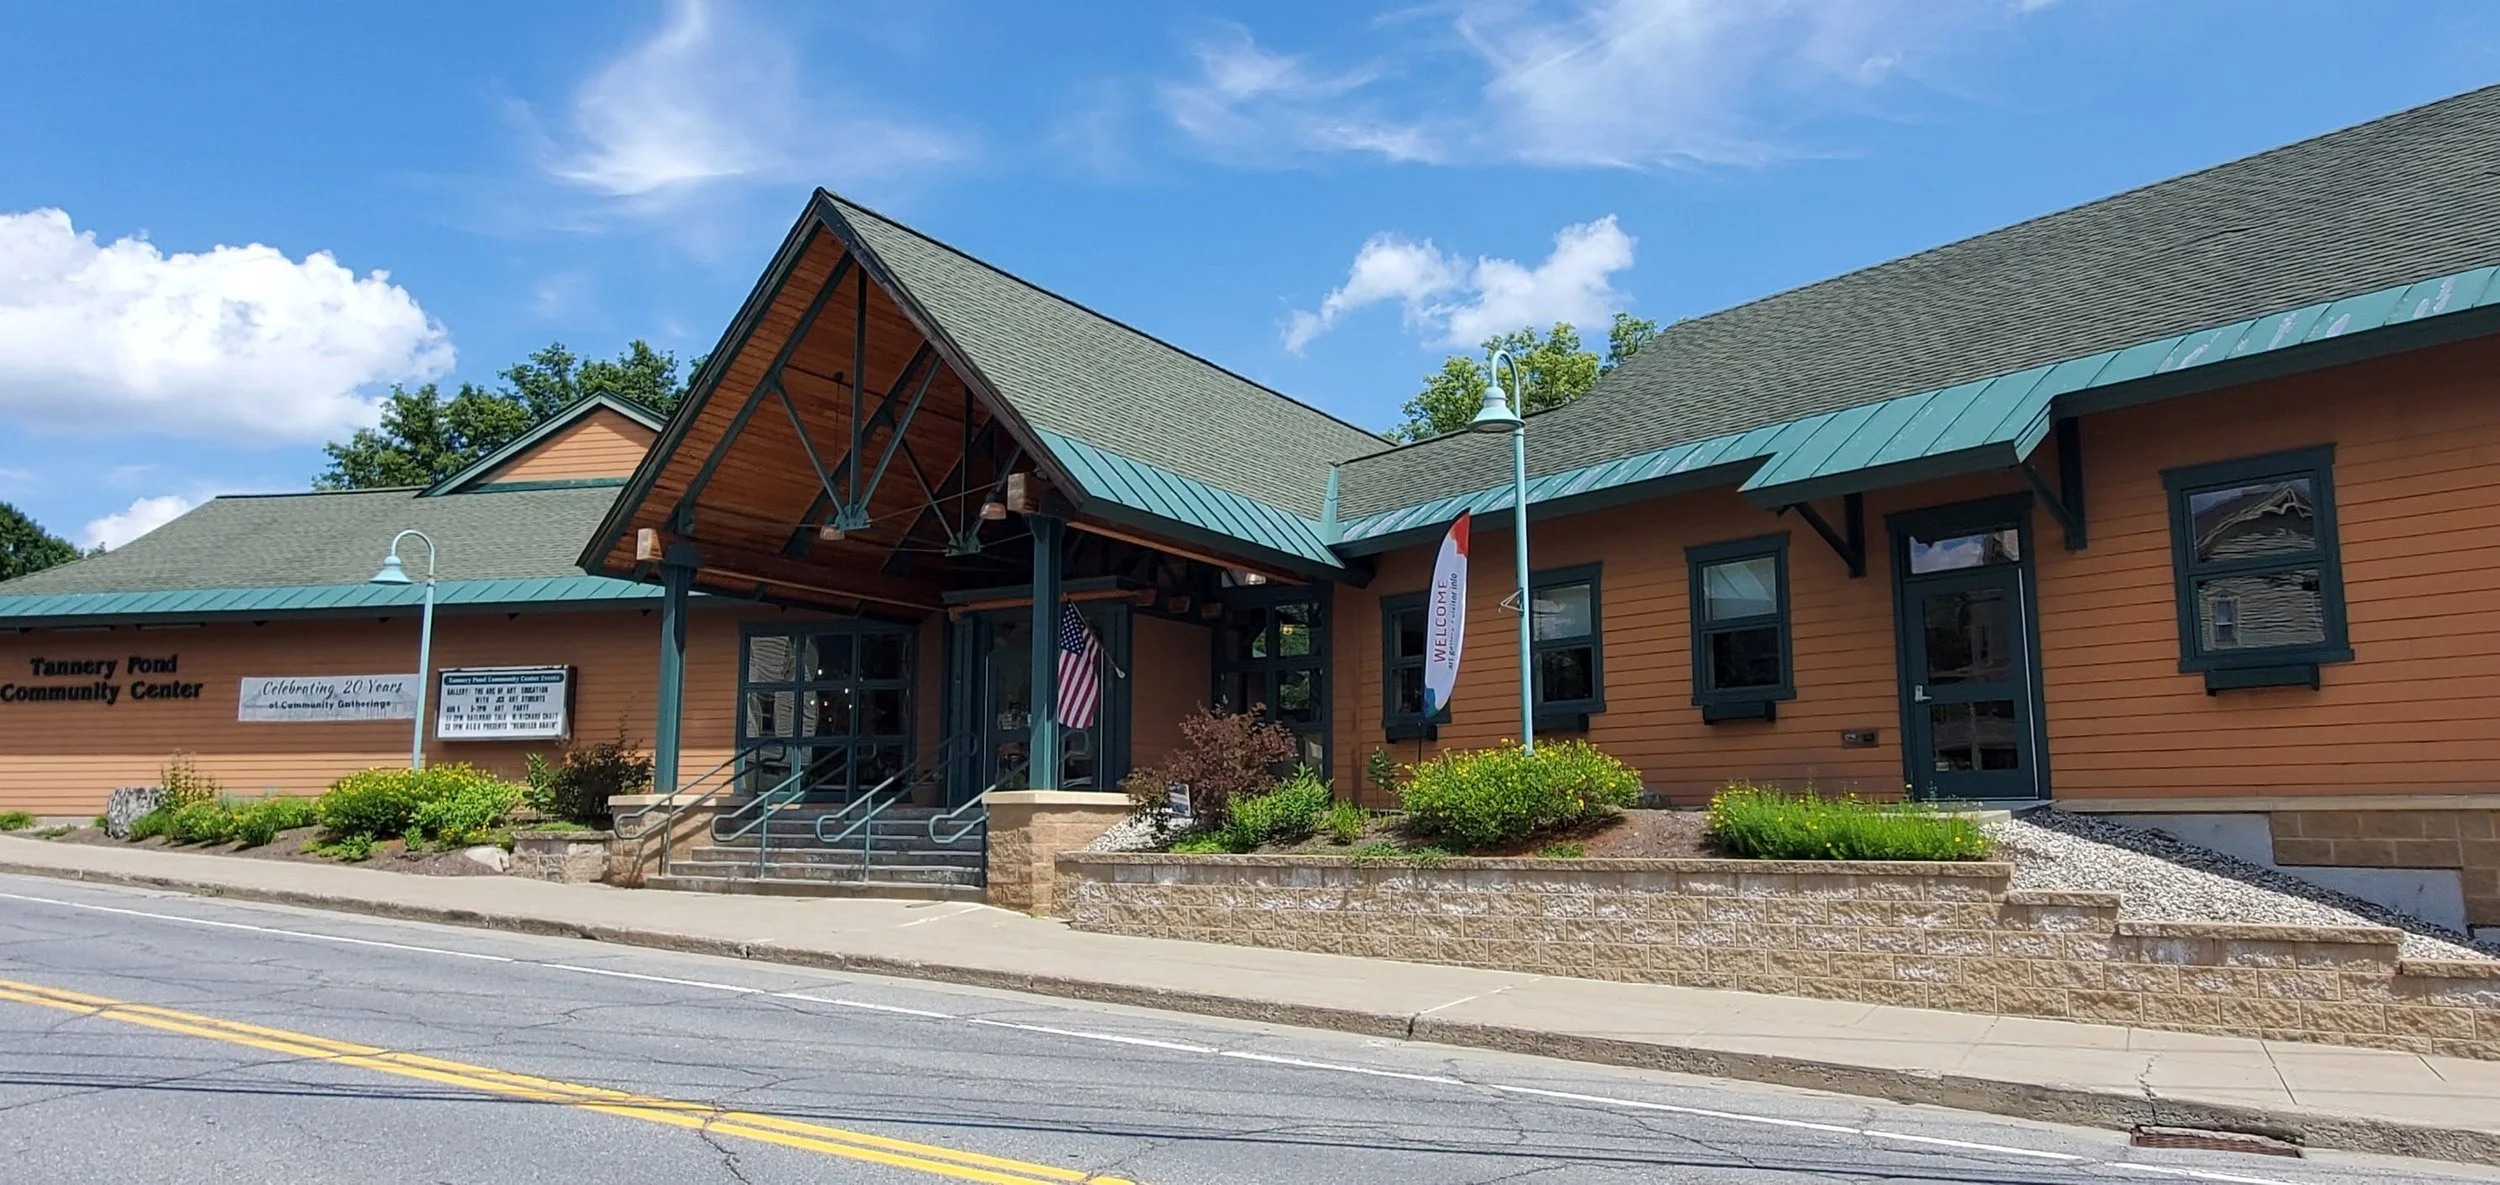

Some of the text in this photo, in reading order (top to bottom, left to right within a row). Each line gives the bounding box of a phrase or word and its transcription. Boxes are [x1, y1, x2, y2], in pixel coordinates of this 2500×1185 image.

[1449, 572, 1458, 590] info
[1434, 580, 1448, 663] WELCOME
[30, 654, 178, 679] Tannery Pond
[472, 676, 487, 684] Pond
[488, 675, 520, 684] Community
[521, 674, 540, 682] Center
[0, 680, 203, 705] Community Center
[262, 679, 403, 700] Celebrating 20 Years
[474, 687, 484, 696] THE
[506, 686, 516, 694] ART
[521, 686, 548, 694] EDUCATION
[268, 700, 391, 710] of Community Gatherings
[508, 695, 518, 703] ART
[494, 704, 505, 712] ART
[513, 704, 529, 712] PARTY
